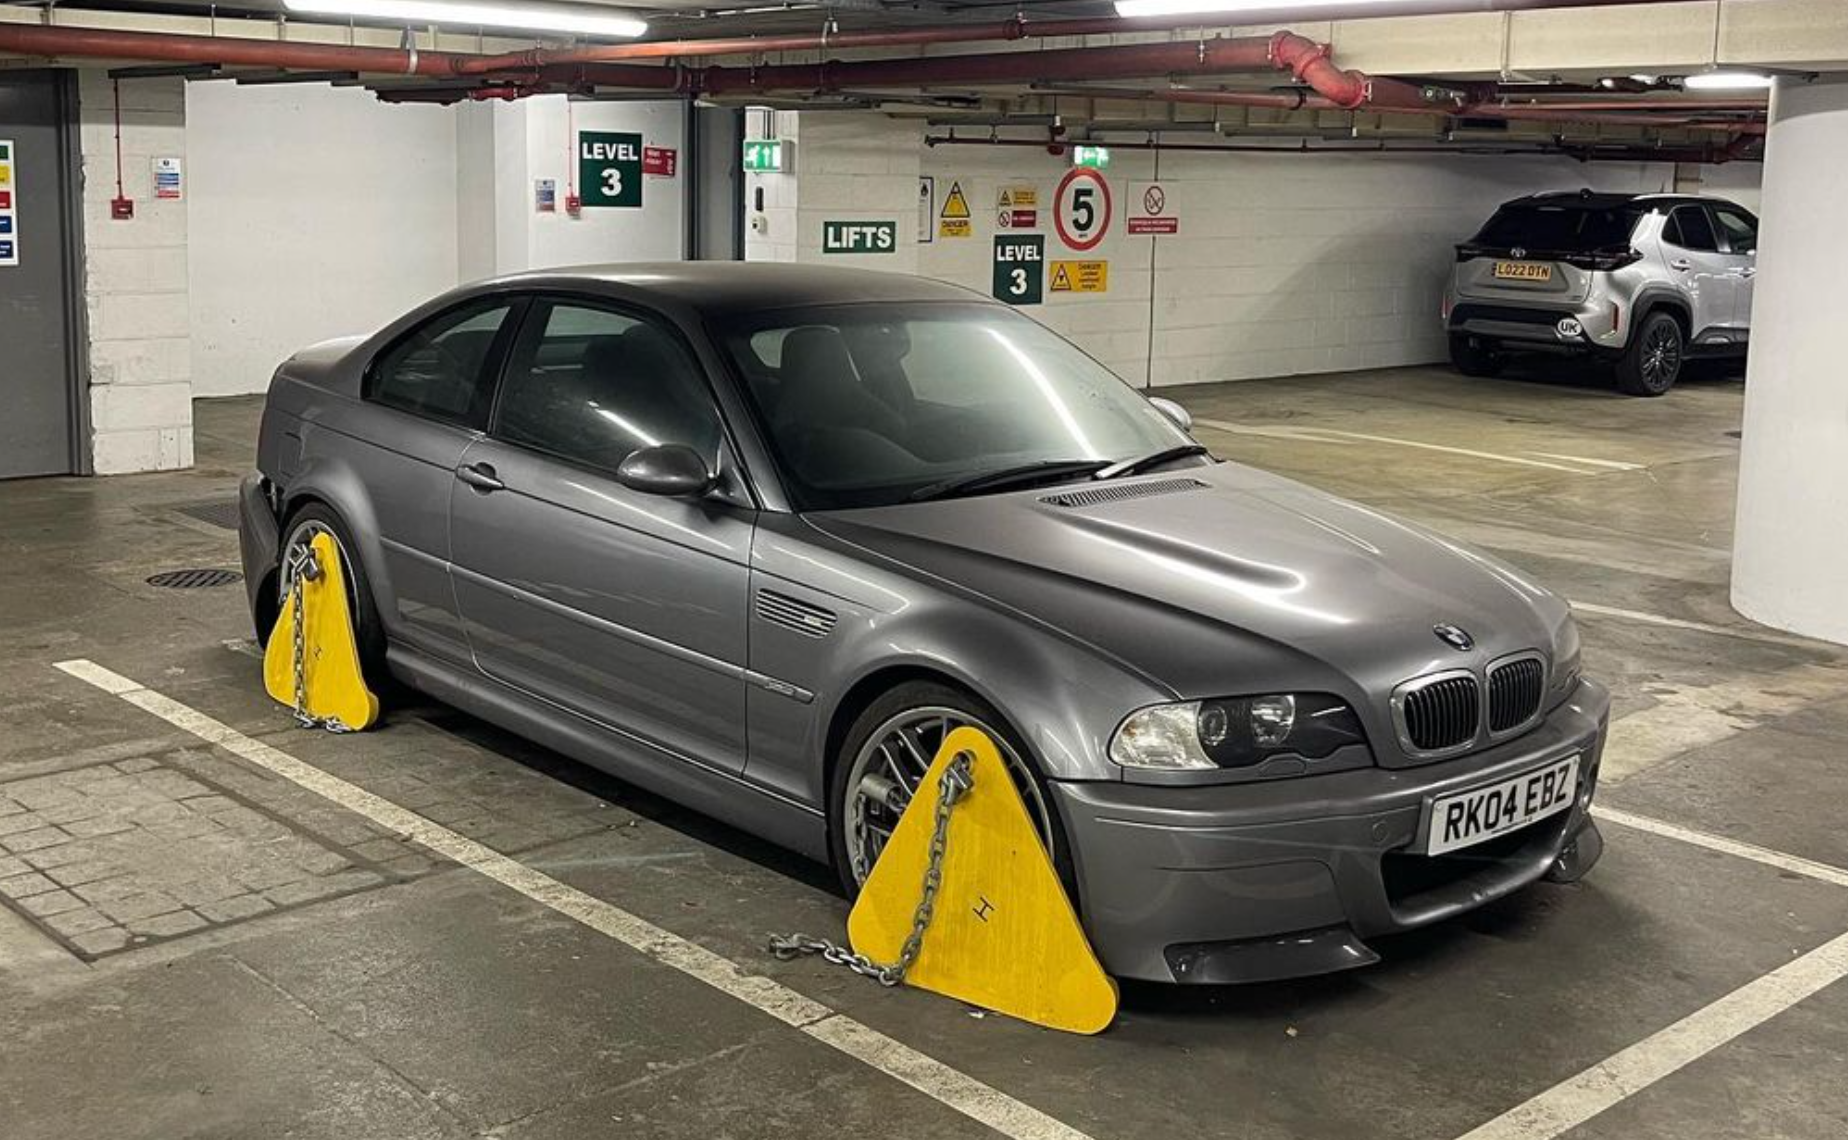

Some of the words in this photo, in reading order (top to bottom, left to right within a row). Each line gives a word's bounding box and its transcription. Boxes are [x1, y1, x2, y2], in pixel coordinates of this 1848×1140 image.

[582, 141, 639, 161] LEVEL
[600, 168, 622, 197] 3
[1072, 188, 1094, 232] 5
[827, 226, 892, 248] LIFTS
[996, 244, 1041, 261] LEVEL
[1010, 269, 1028, 295] 3
[1561, 322, 1577, 333] UK
[1443, 784, 1518, 842] RK04
[1524, 763, 1570, 816] EBZ
